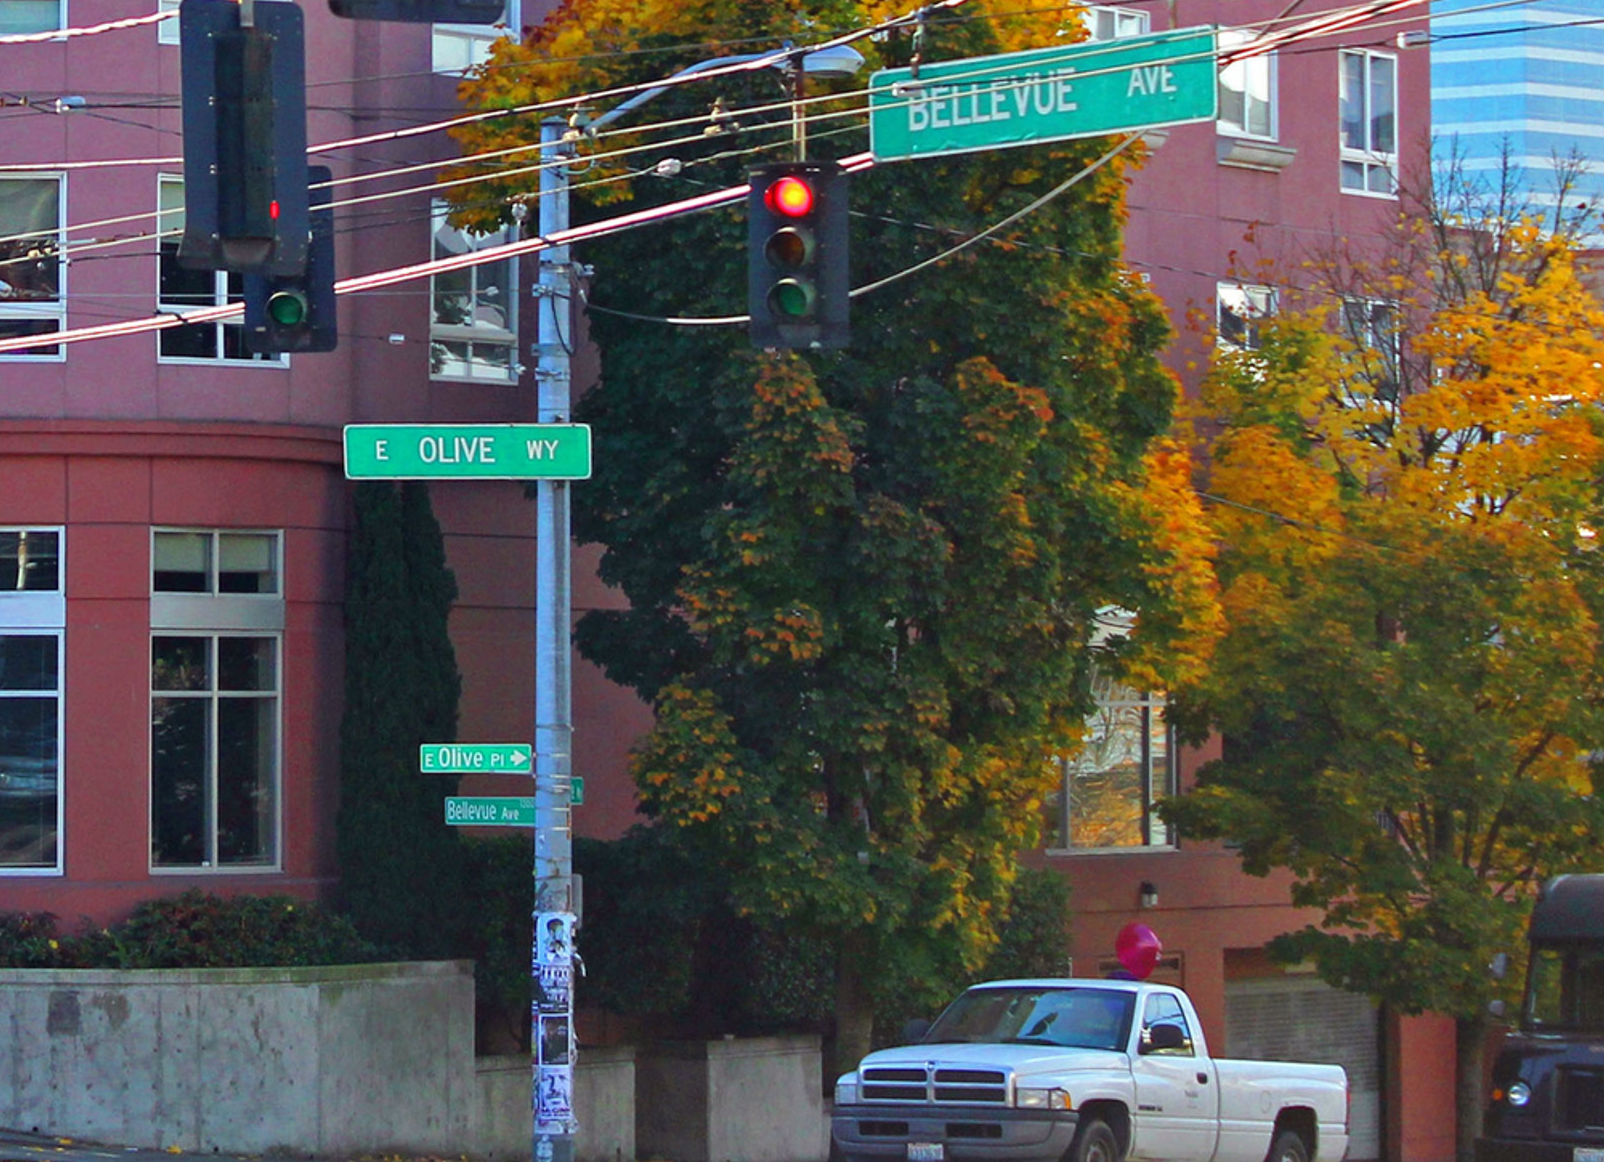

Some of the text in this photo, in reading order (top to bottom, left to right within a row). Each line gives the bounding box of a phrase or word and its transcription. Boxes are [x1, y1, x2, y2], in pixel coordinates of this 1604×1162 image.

[908, 63, 1177, 132] BELLEVUE AVE
[376, 437, 559, 463] E OLIVE WY
[425, 753, 434, 767] E
[439, 747, 483, 767] Olive
[447, 800, 519, 820] Bellevue Ave
